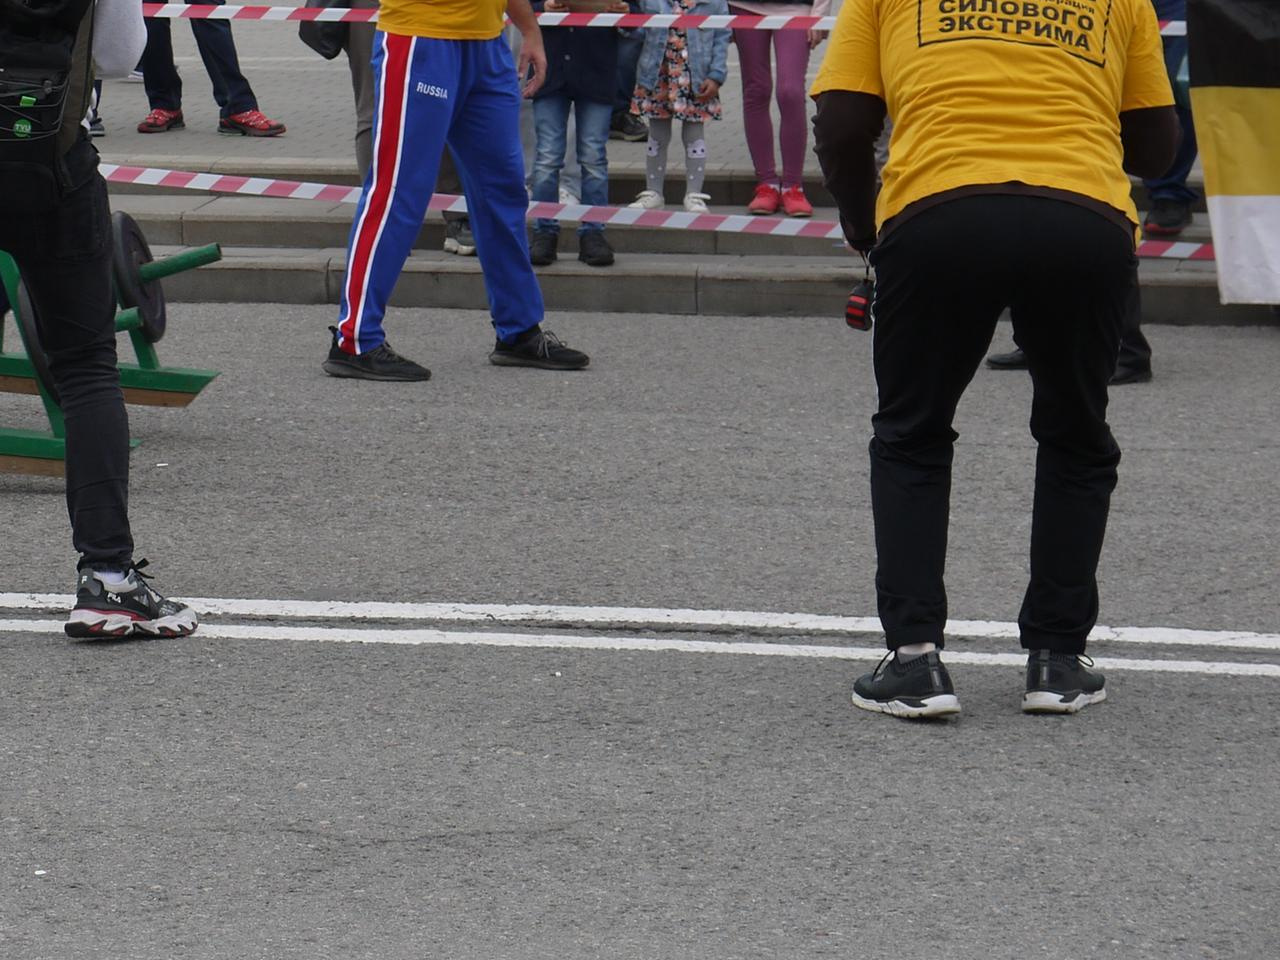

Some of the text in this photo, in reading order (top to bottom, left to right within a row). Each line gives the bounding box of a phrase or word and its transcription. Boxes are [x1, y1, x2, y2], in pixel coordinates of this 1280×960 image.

[938, 15, 1090, 52] ЭКСТРИМА
[416, 81, 448, 100] RUSSIA
[107, 592, 121, 604] FILA
